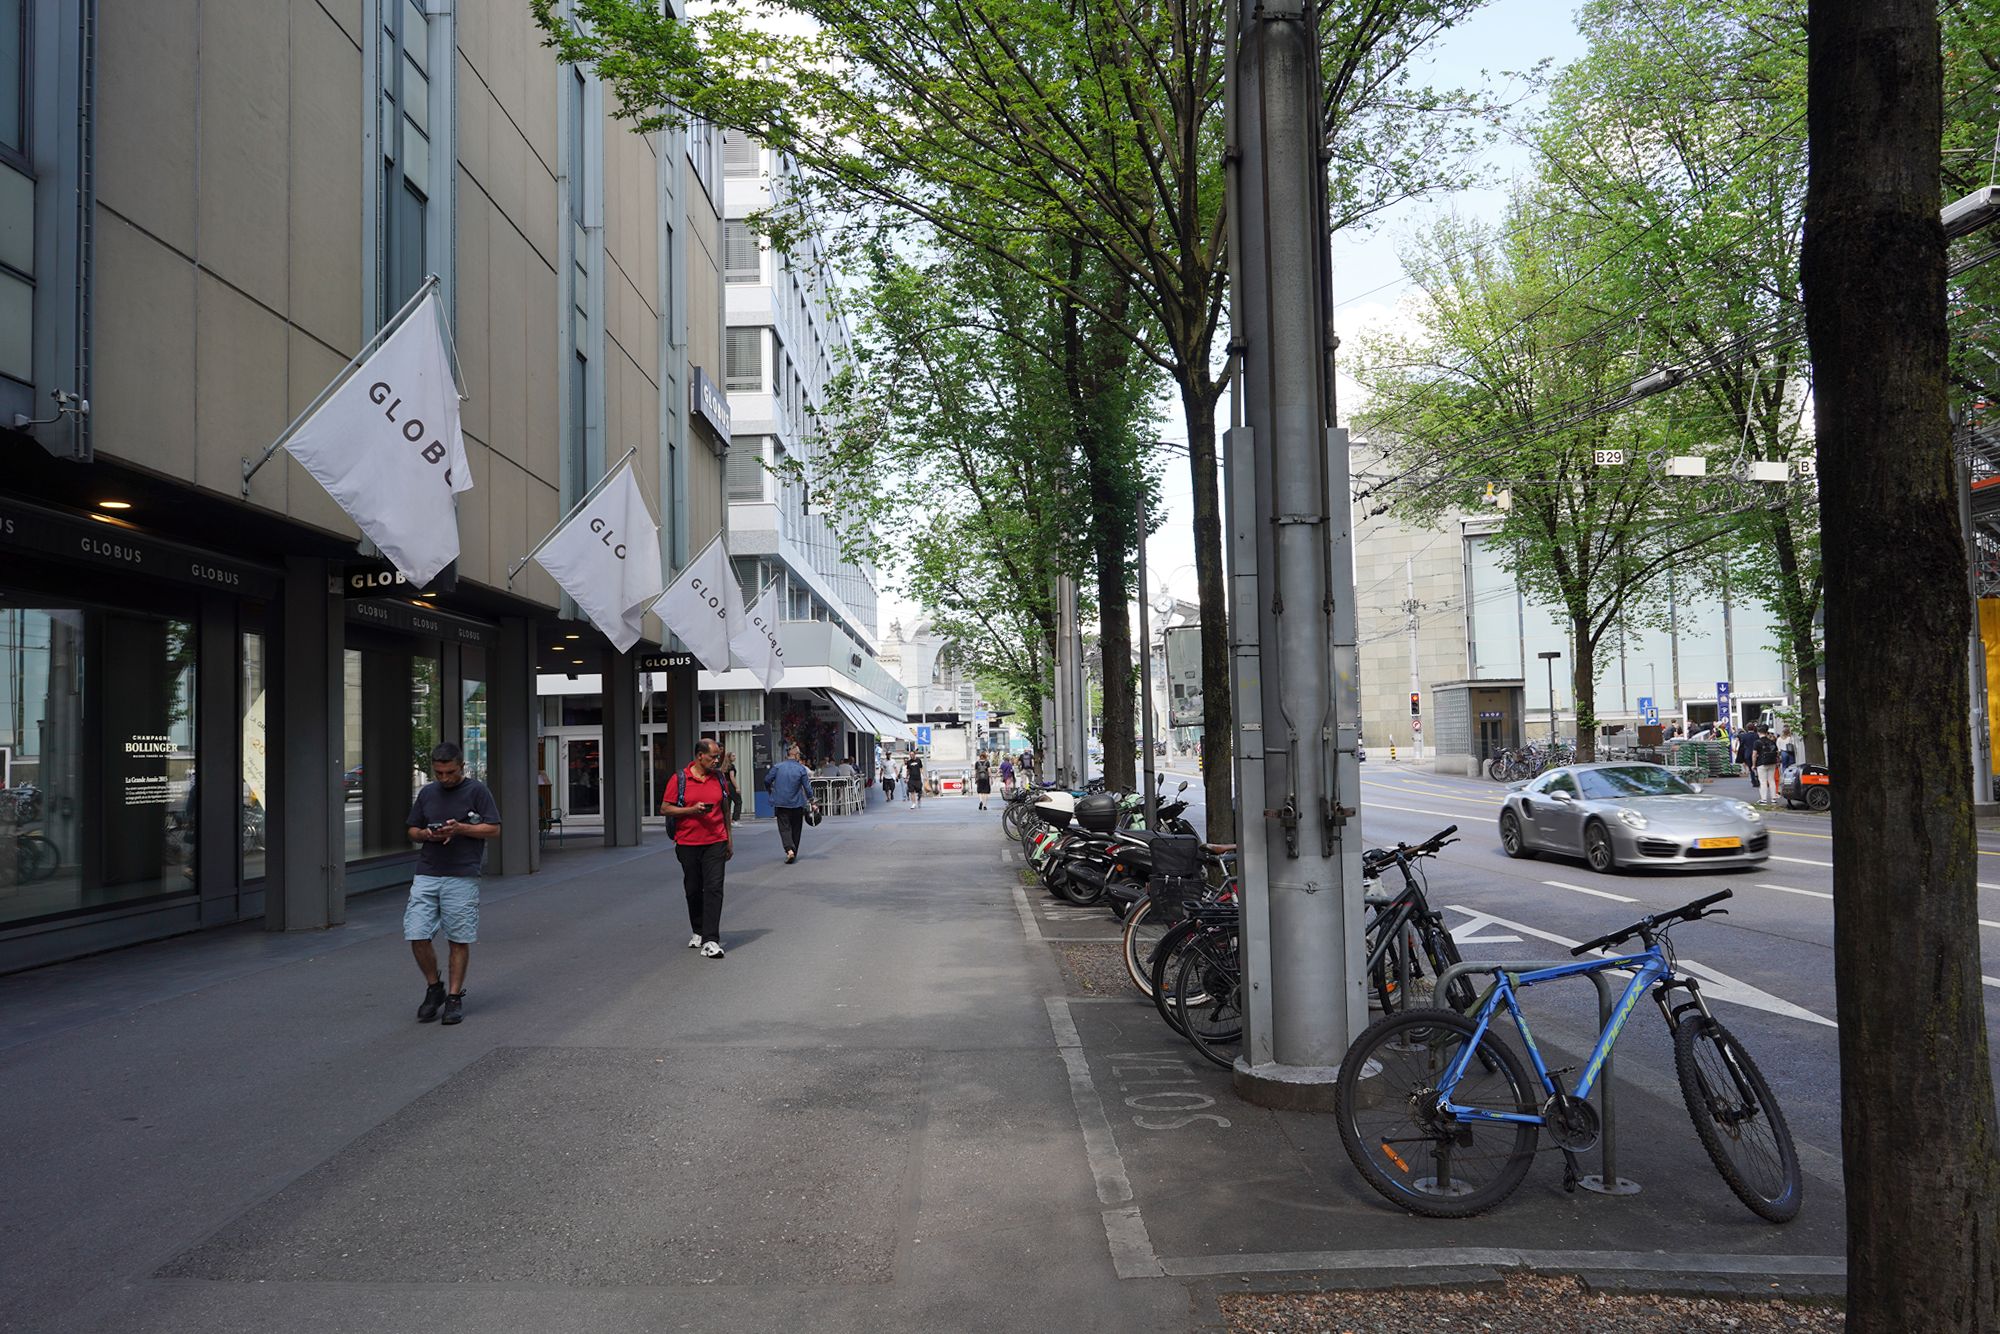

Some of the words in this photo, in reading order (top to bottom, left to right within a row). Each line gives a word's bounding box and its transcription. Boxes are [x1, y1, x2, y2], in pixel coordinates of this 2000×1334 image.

[703, 385, 730, 431] GLOBUS
[369, 382, 452, 488] GLOB
[1596, 451, 1622, 463] B29
[1801, 461, 1810, 472] B
[590, 518, 626, 560] GLO
[81, 537, 142, 564] GLOBUS
[191, 564, 239, 586] GLOBUS
[351, 570, 406, 589] GLOB
[691, 578, 726, 619] GLOB
[357, 603, 389, 620] GLOBUS
[412, 617, 438, 631] GLOBUS
[458, 628, 480, 641] GLOBUS
[753, 616, 784, 665] GLOBU
[645, 656, 691, 668] GLOBUS
[125, 742, 178, 753] BOLLINGER
[1586, 978, 1644, 1087] PHOENIX
[1103, 1050, 1232, 1130] VELOS
